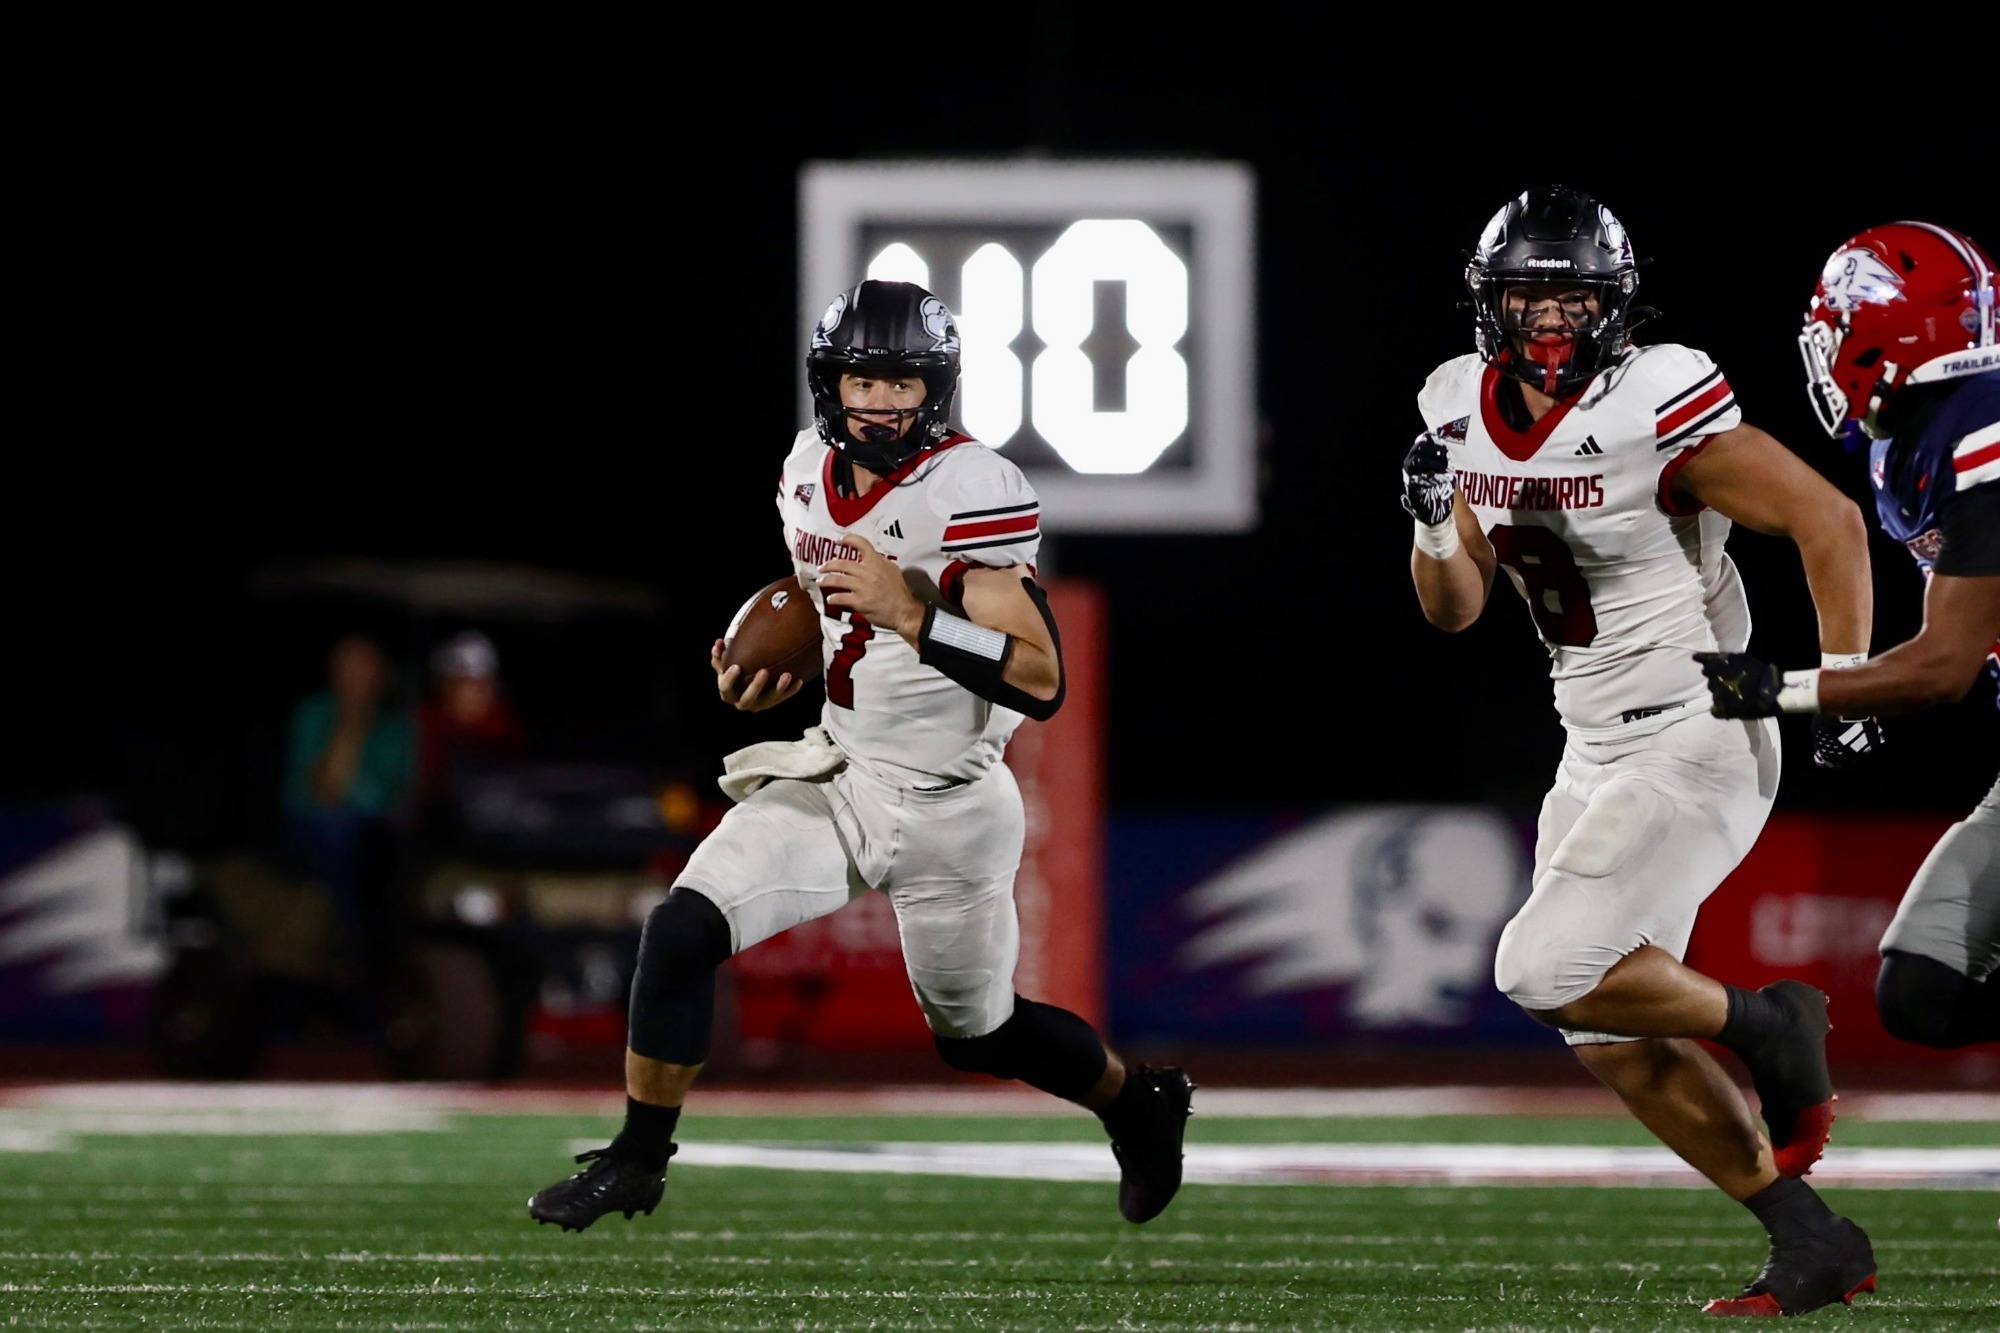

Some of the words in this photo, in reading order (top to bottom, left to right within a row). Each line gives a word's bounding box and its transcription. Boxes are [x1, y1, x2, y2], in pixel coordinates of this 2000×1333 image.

[1527, 258, 1571, 268] Riddell
[1455, 469, 1604, 511] THUNDERBIRDS
[1487, 523, 1598, 647] 8
[819, 586, 876, 711] 7
